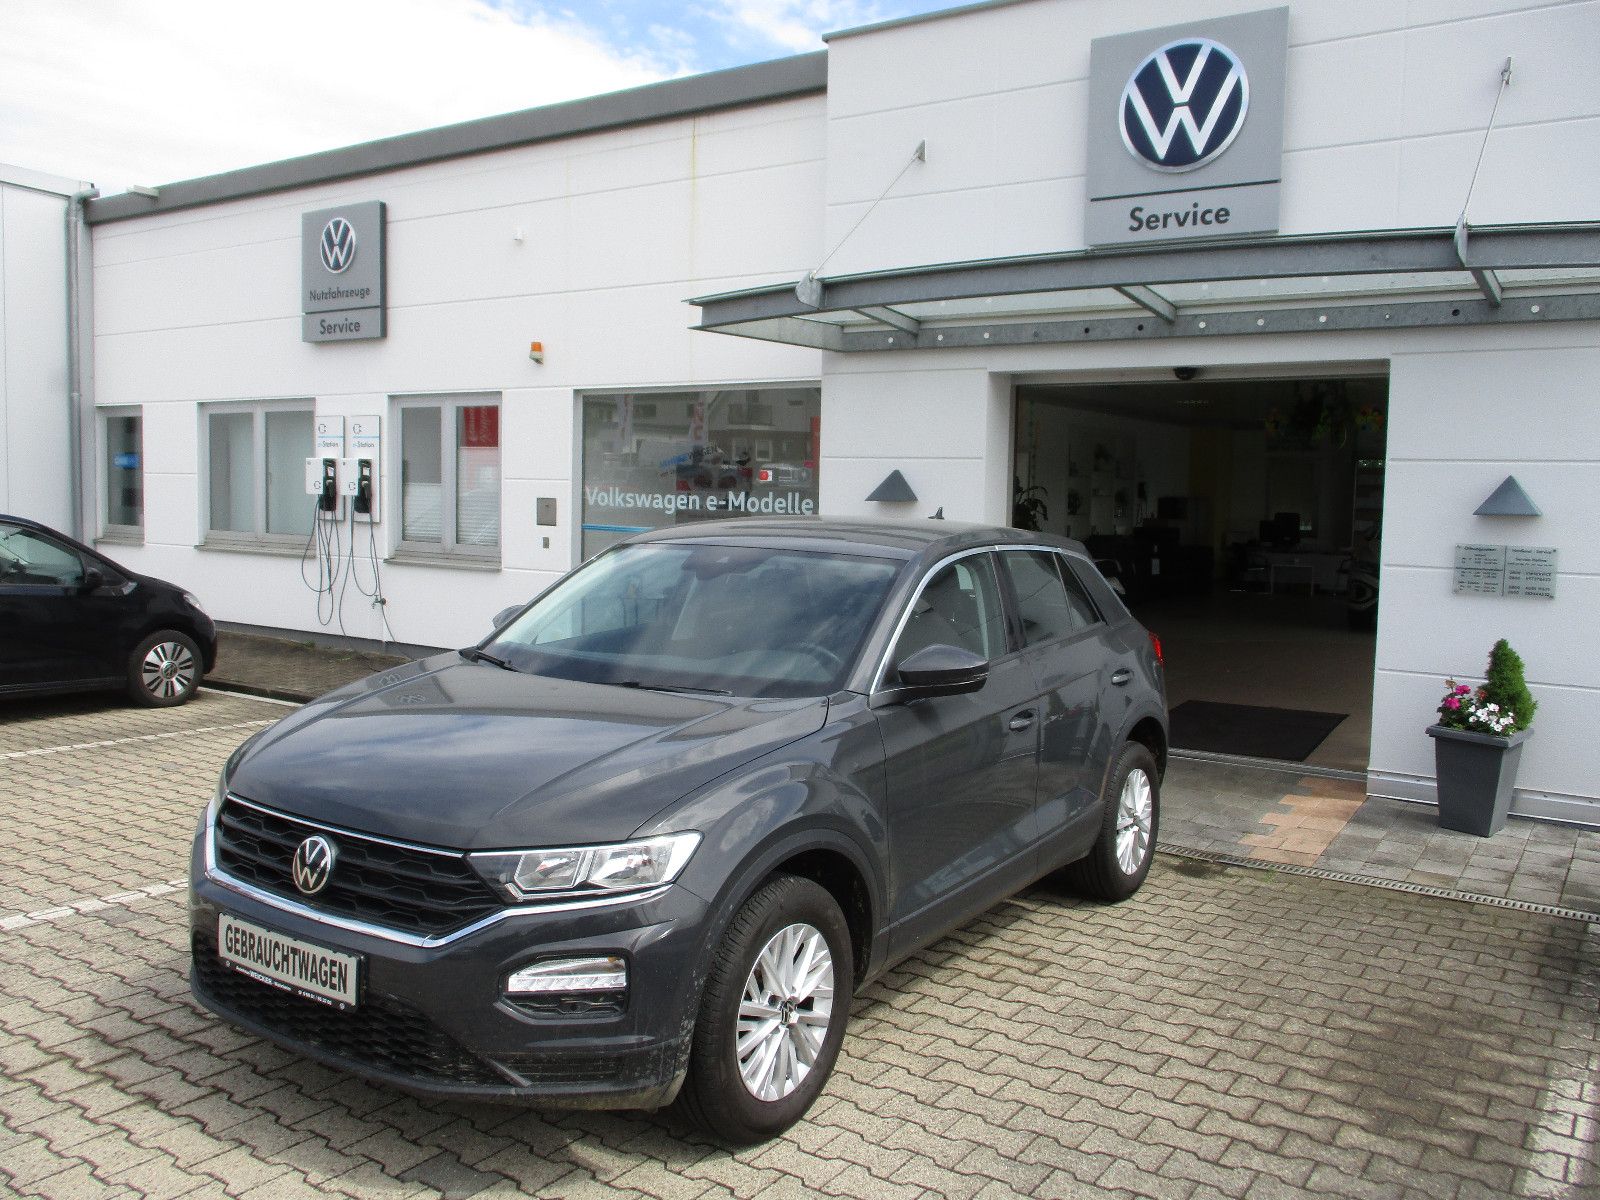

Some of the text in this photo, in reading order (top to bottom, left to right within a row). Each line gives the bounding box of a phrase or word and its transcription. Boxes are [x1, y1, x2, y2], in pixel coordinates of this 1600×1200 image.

[1128, 202, 1231, 232] Service
[309, 286, 371, 301] Nutzfahrzeuge
[319, 317, 361, 335] Service
[585, 486, 814, 515] Volkswagen e-Modelle
[225, 923, 348, 994] GEBRAUCHTWAGEN
